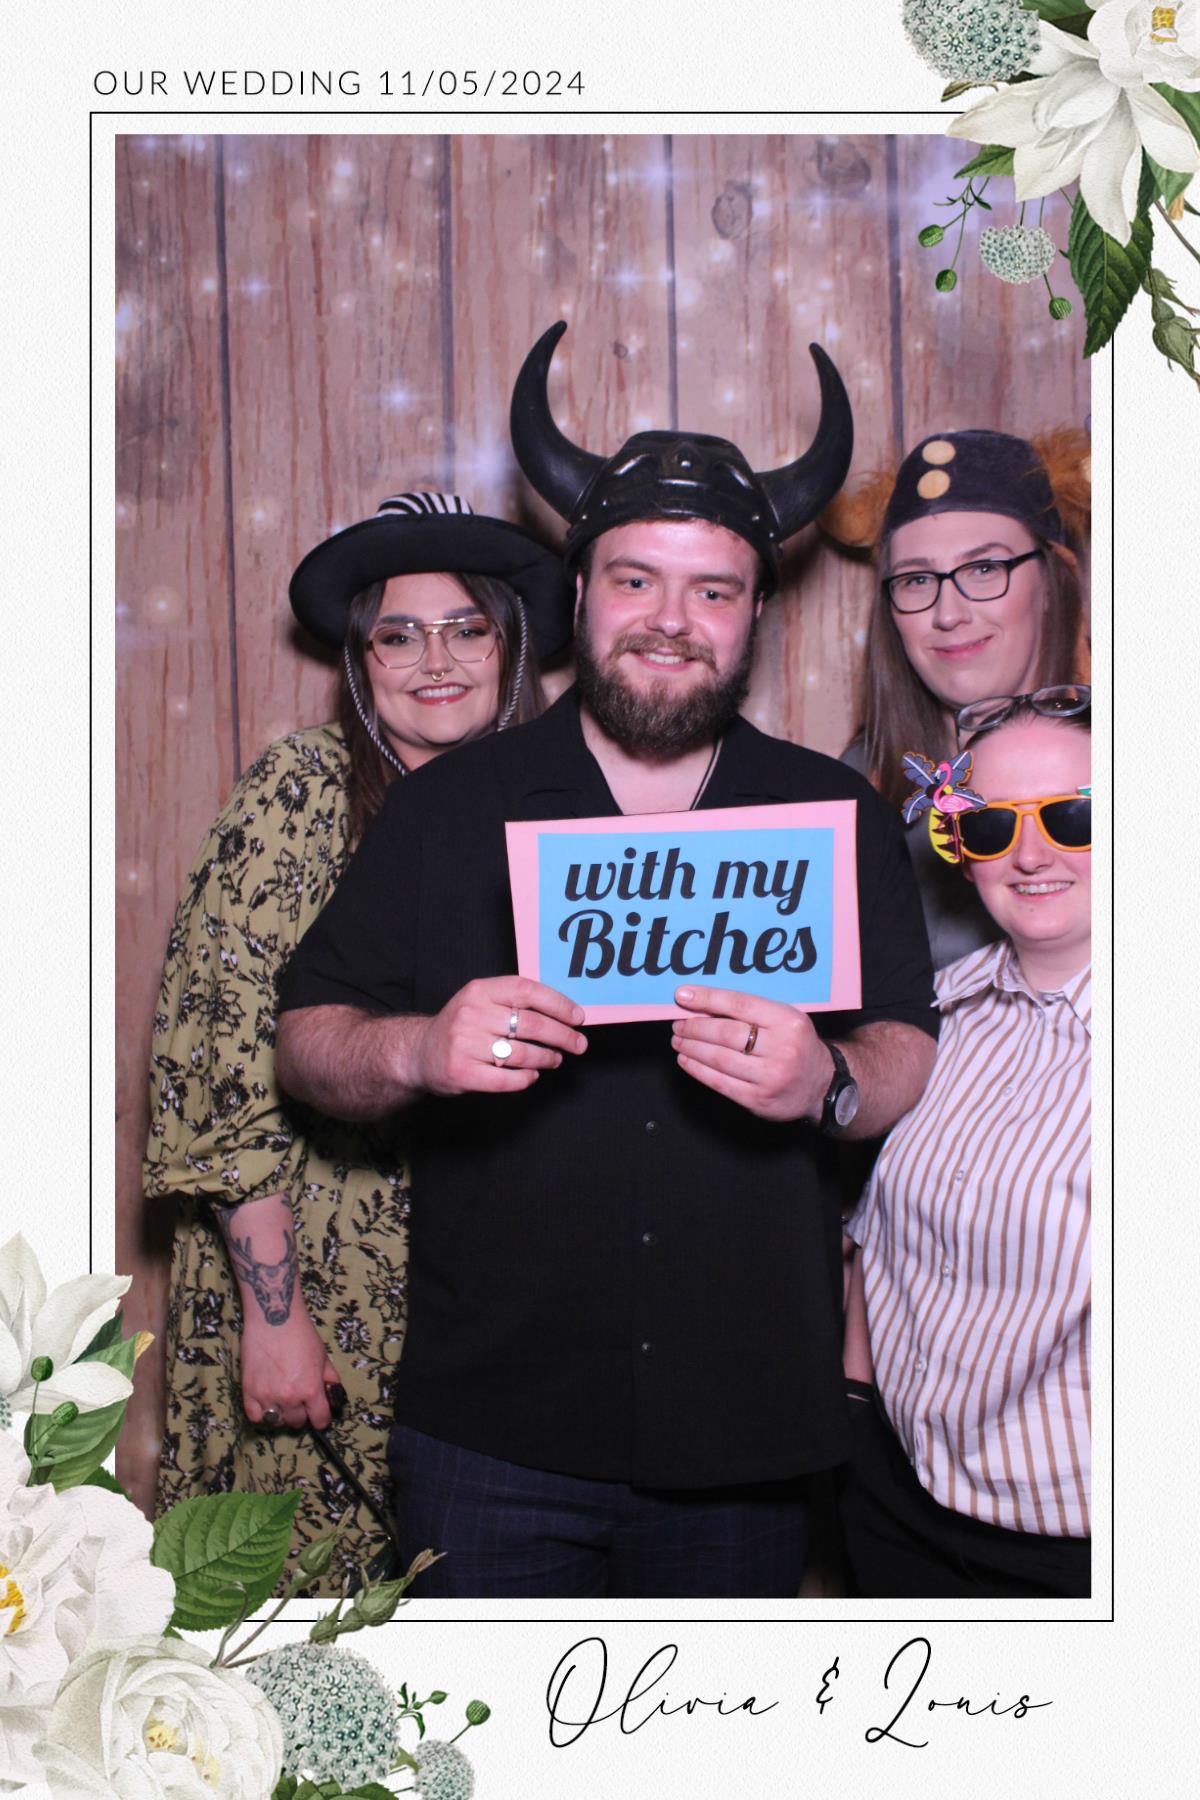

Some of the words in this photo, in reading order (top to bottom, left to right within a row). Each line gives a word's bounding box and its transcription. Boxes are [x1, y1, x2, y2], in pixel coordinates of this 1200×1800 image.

[564, 847, 697, 901] with
[711, 859, 810, 916] my
[558, 909, 818, 979] Bitches
